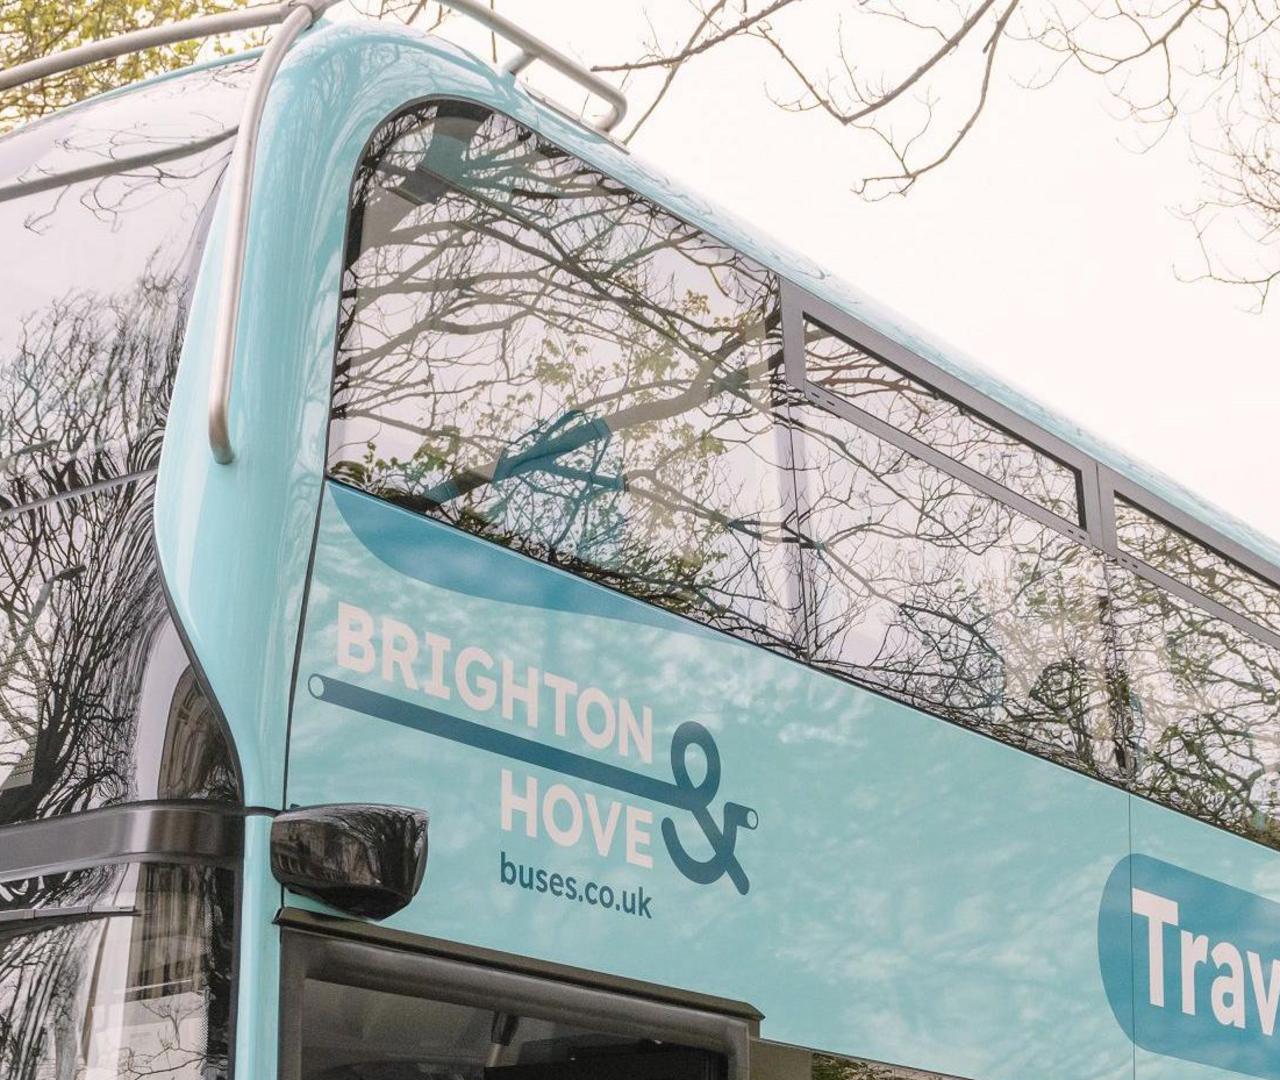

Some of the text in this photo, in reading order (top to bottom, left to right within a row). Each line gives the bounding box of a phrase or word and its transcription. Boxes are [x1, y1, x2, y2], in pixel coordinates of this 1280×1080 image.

[336, 600, 653, 763] BRIGHTON
[500, 768, 654, 869] HOVE
[499, 850, 653, 920] buses.co.uk
